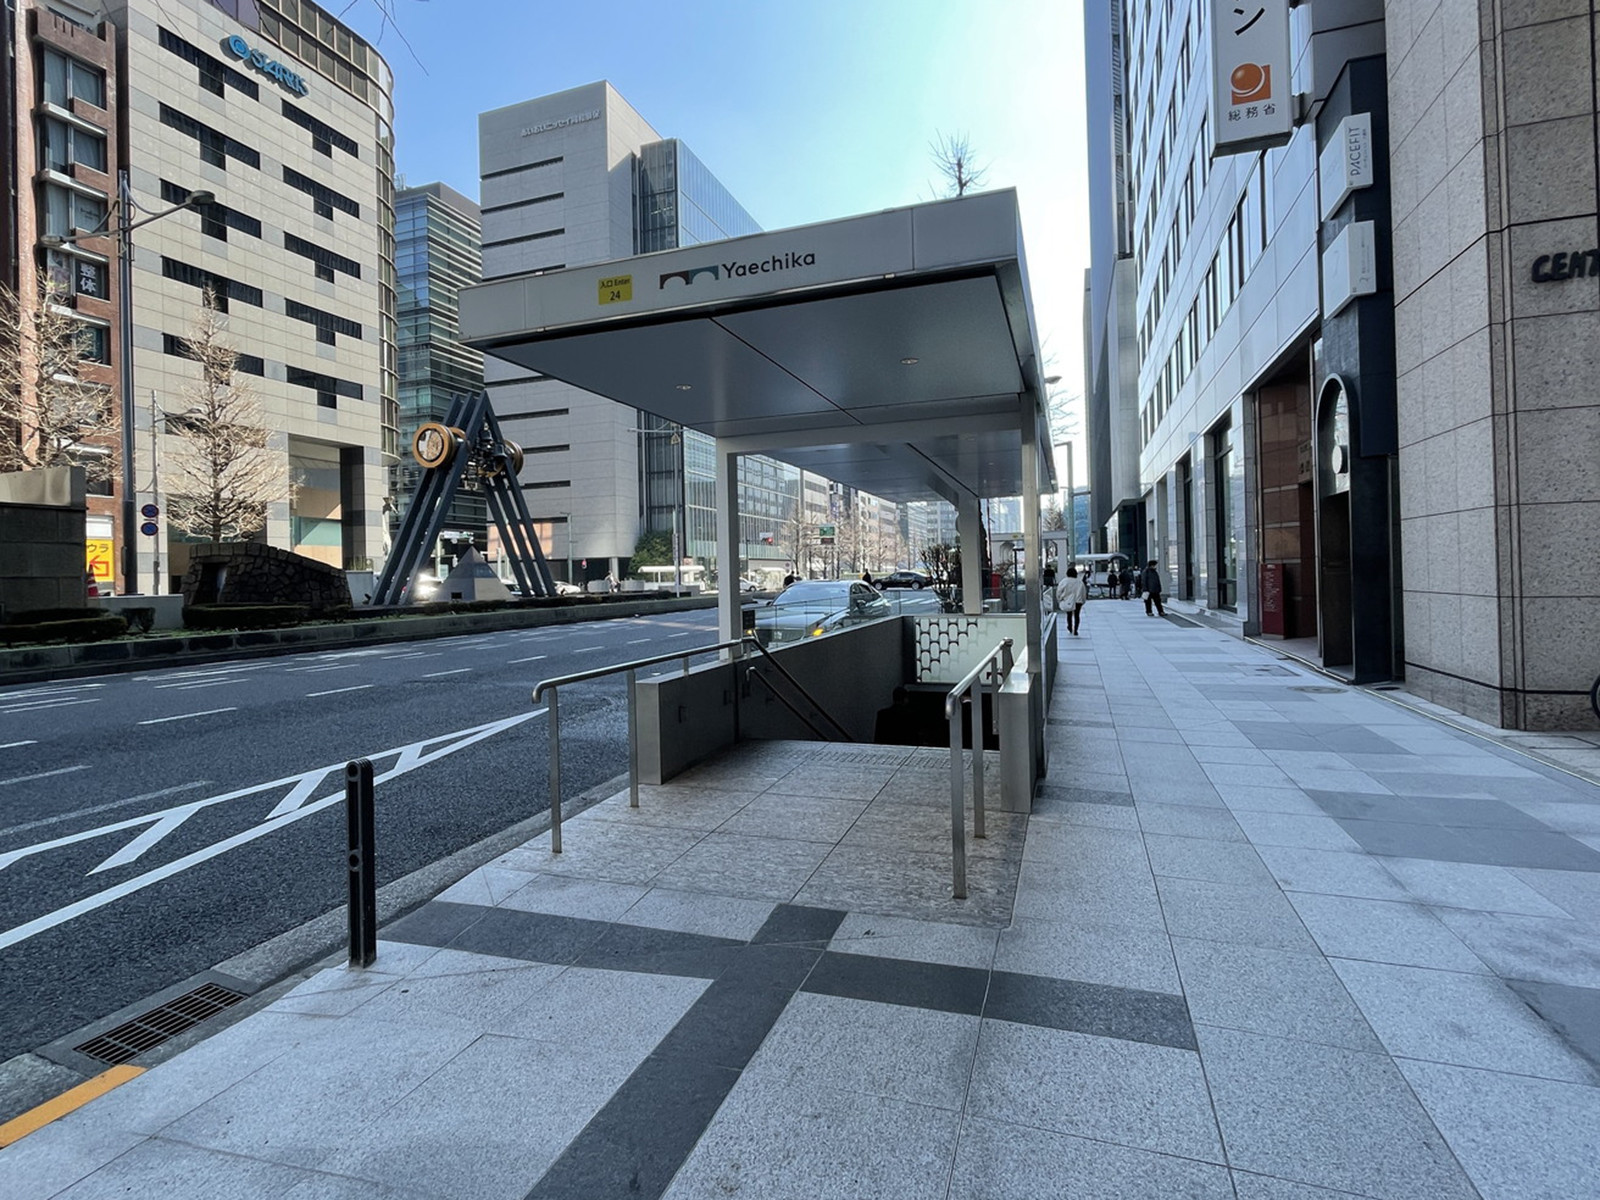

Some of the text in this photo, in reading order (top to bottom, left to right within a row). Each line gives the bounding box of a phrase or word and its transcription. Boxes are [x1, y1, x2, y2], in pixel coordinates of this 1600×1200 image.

[1233, 0, 1265, 36] ン
[1228, 103, 1276, 122] 総務省
[1349, 127, 1361, 177] PACEFIT
[80, 262, 97, 293] 整体
[722, 252, 815, 278] Yaechika
[600, 280, 613, 289] 入口
[610, 290, 621, 301] 24
